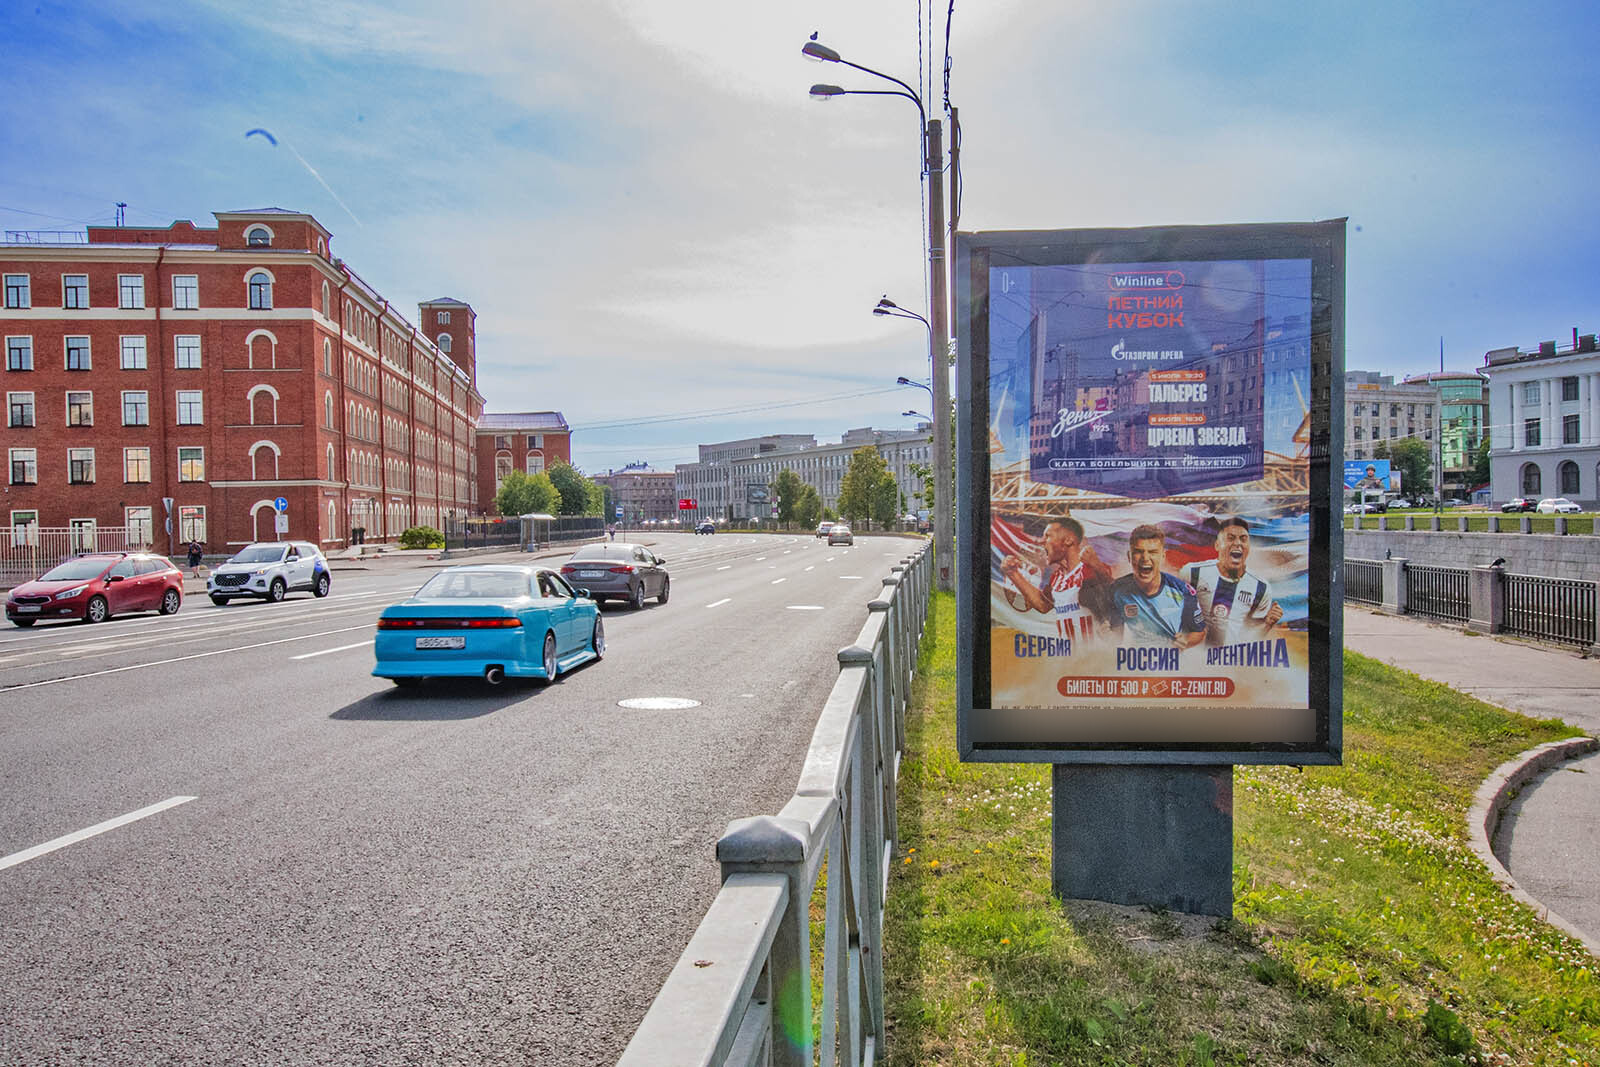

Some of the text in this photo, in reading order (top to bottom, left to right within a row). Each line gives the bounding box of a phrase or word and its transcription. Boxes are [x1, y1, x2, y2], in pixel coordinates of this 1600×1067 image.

[1115, 276, 1163, 286] Winline
[1108, 293, 1183, 310] ЛЕТНИЙ
[1107, 312, 1184, 328] КУБОК
[1160, 351, 1184, 360] АРЕНА
[1148, 384, 1208, 402] ТАЛЬЕРЕС
[1092, 424, 1110, 432] 1925
[1147, 427, 1247, 447] ЦРВЕНА ЗВЕЗДА
[1014, 633, 1071, 658] СЕРБИЯ
[1206, 638, 1290, 668] АРГЕНТИНА
[1116, 647, 1179, 671] РОССИЯ
[1066, 680, 1104, 695] БИЛЕТЫ
[1107, 680, 1118, 695] ОТ
[1121, 680, 1138, 695] 500
[1171, 680, 1227, 695] FC-ZENIT.RU
